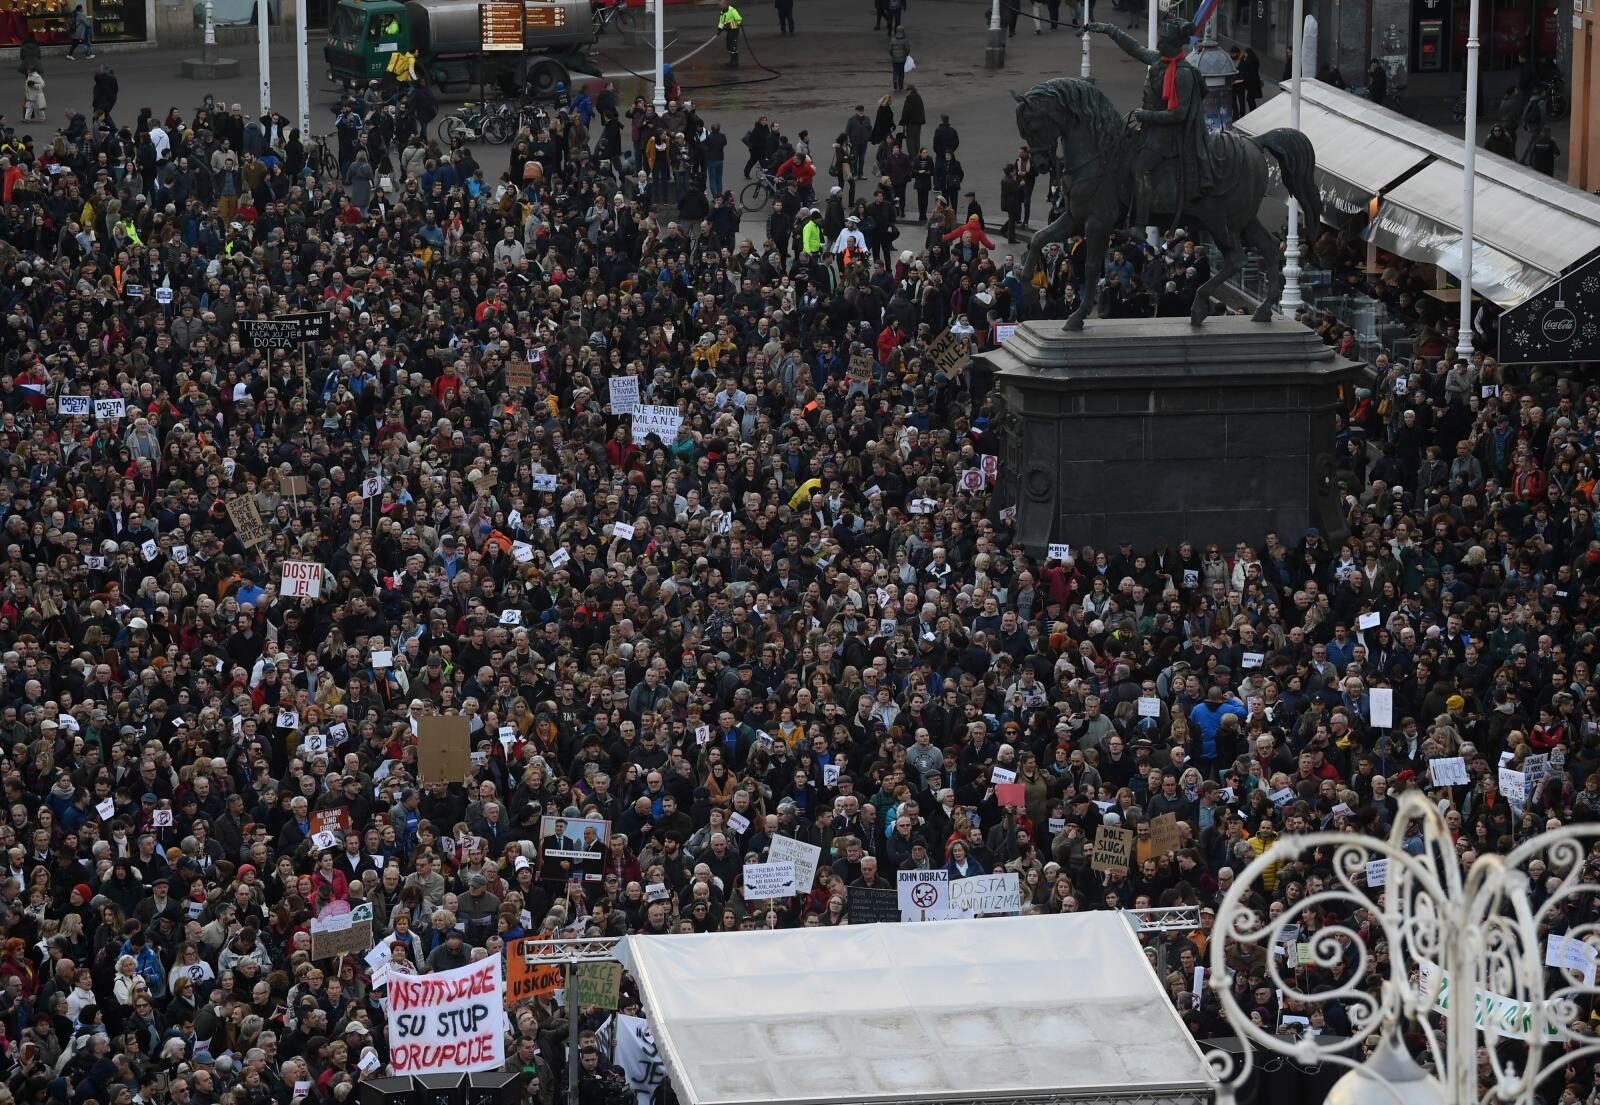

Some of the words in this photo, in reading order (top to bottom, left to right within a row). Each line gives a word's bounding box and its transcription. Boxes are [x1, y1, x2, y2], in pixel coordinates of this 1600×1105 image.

[251, 322, 279, 331] KRAVA
[280, 323, 297, 331] ZNA
[250, 330, 271, 338] KADA
[254, 337, 293, 348] DOSTA
[930, 332, 954, 360] DOLE
[937, 344, 965, 374] MILE
[62, 398, 88, 406] DOSTA
[97, 401, 122, 411] DOSTA
[633, 405, 648, 415] NE
[654, 406, 678, 417] BRINI
[632, 415, 677, 427] MILANE
[283, 562, 320, 580] DOSTA
[292, 580, 310, 597] JE!
[324, 809, 342, 818] DAMO
[323, 816, 337, 825] KINO
[319, 822, 341, 833] EUROPA
[1103, 828, 1124, 841] DOLE
[1097, 839, 1125, 856] SLUGA
[1093, 852, 1128, 868] KAPITALA
[747, 871, 790, 880] KORONAVIRUS
[898, 872, 917, 882] JOHN
[919, 871, 949, 882] OBRAZ
[951, 876, 1006, 900] DOSTA
[949, 893, 1020, 912] BANDITIZMA
[389, 965, 496, 1012] INSTITUCIJE
[396, 1014, 426, 1038] SU
[436, 1004, 489, 1038] STUP
